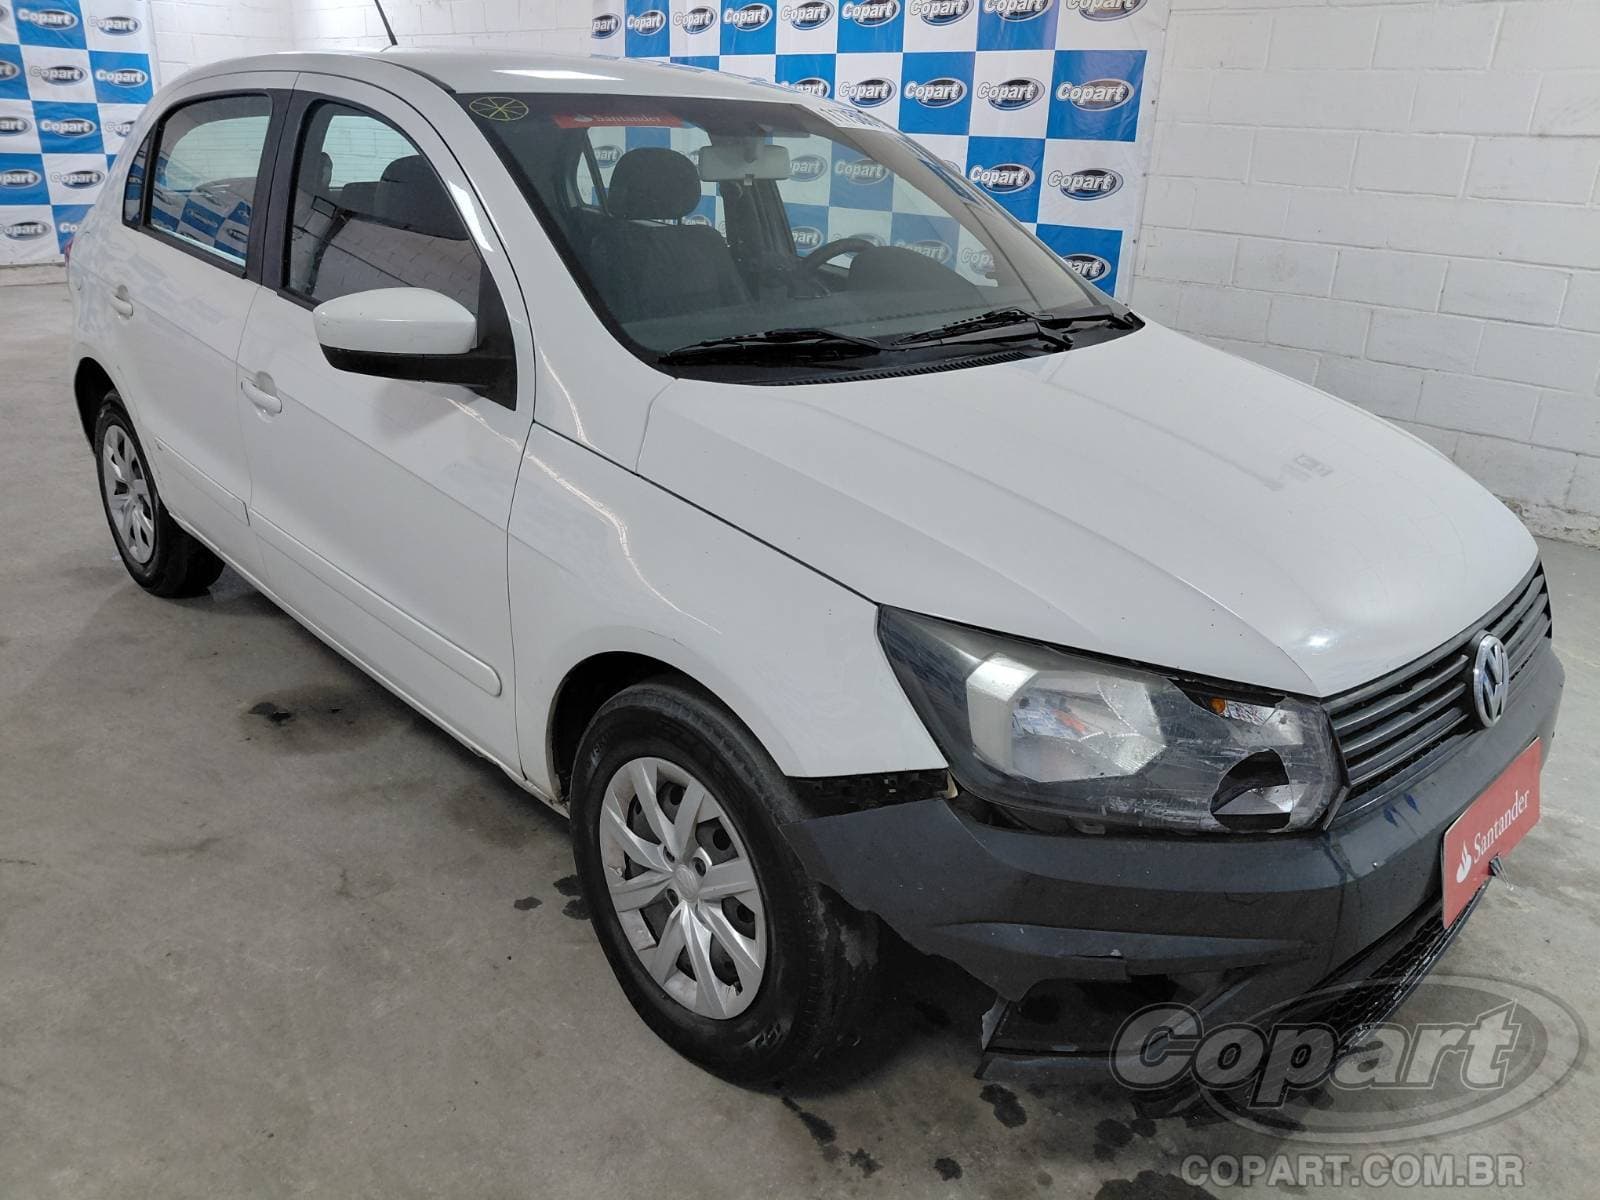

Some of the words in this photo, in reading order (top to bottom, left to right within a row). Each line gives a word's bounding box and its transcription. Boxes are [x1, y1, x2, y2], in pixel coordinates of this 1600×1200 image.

[17, 8, 71, 26] Copart
[723, 7, 767, 28] Copart
[781, 5, 828, 25] Copart
[842, 1, 896, 23] Copart
[911, 0, 966, 21] Copart
[983, 0, 1045, 17] Copart
[87, 16, 136, 33] Copart
[592, 18, 616, 33] part
[627, 14, 661, 32] Copart
[673, 10, 712, 31] Copart
[29, 66, 81, 82] Copart
[95, 69, 143, 84] Copart
[839, 81, 890, 101] Copart
[904, 82, 959, 103] Copart
[977, 82, 1037, 103] Copart
[1056, 81, 1125, 105] Copart
[0, 118, 24, 131] art
[40, 118, 91, 135] Copart
[105, 121, 131, 135] Cop
[51, 171, 98, 187] Copart
[834, 160, 883, 179] Copart
[969, 165, 1026, 190] Copart
[1047, 169, 1114, 193] Copart
[1473, 788, 1530, 865] Santander
